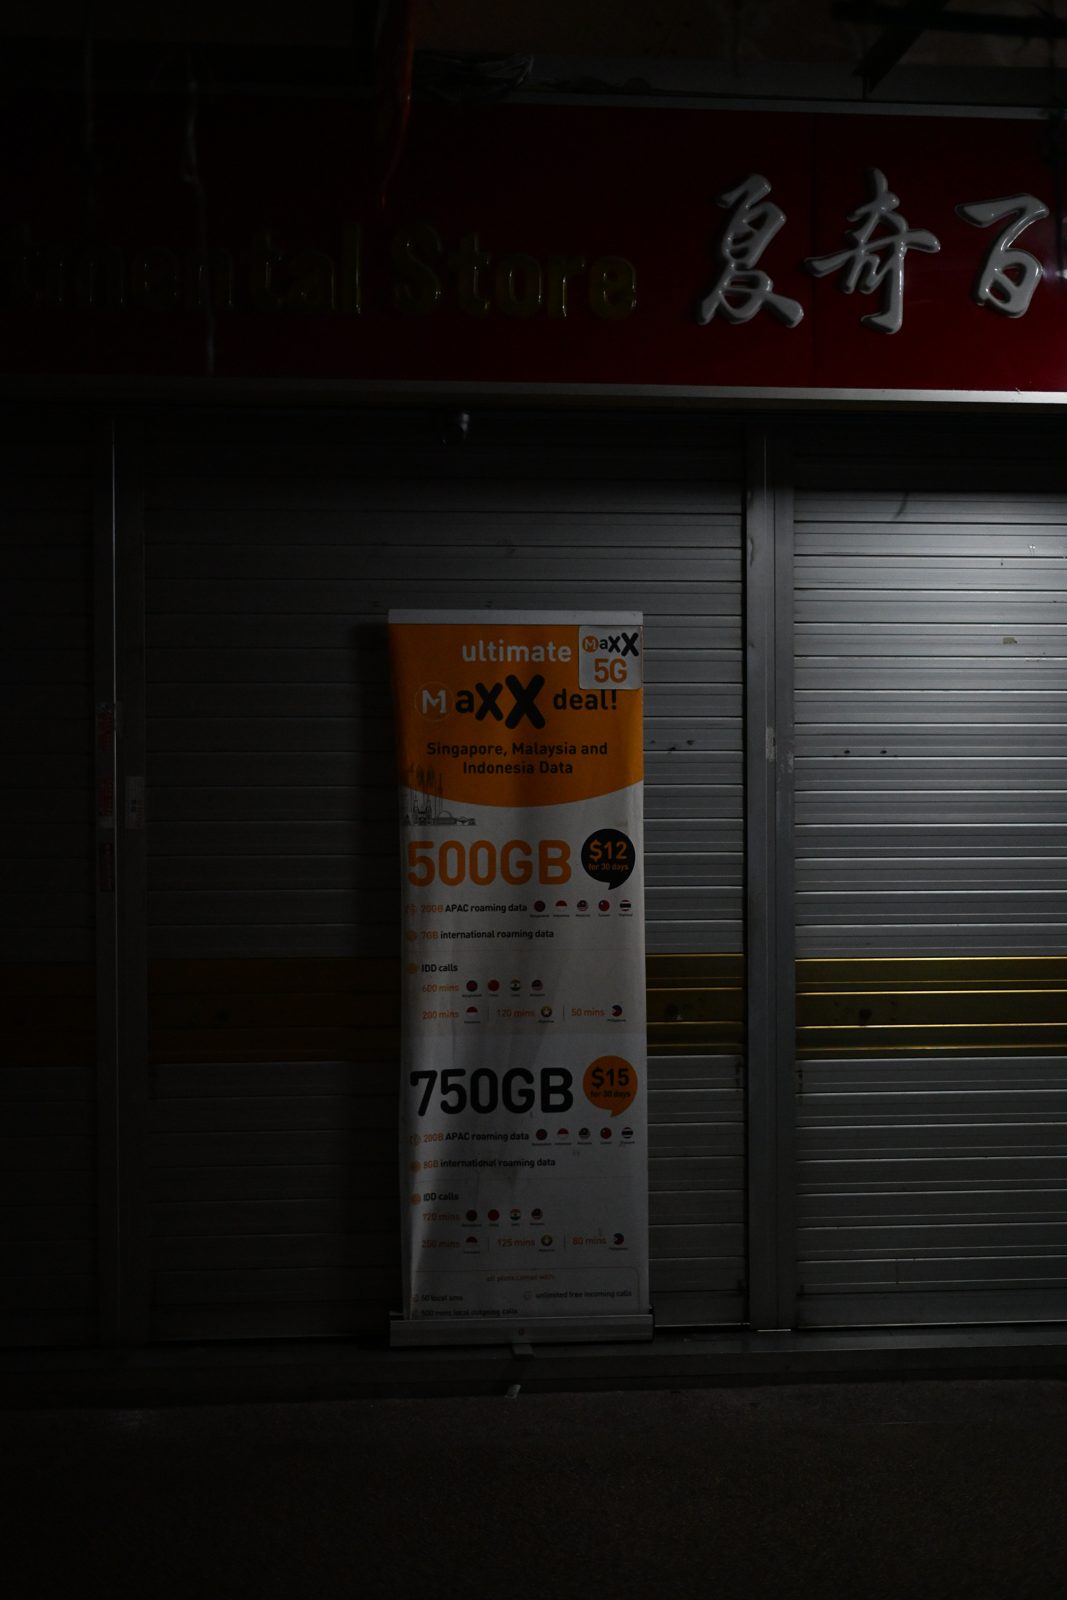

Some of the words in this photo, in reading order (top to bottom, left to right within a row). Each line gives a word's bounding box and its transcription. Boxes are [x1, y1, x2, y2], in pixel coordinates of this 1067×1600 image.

[392, 221, 640, 320] Store
[462, 640, 572, 663] ultimate
[594, 658, 628, 683] 5G
[553, 689, 617, 710] deal!
[427, 742, 507, 758] Singapore,
[512, 742, 576, 758] Malaysia
[581, 742, 608, 755] and
[464, 761, 534, 775] Indonesia
[540, 761, 573, 774] Data
[589, 839, 628, 862] $12
[407, 839, 572, 887] 500GB
[588, 863, 600, 871] for
[611, 863, 629, 872] days
[445, 903, 469, 913] APAC
[471, 903, 506, 914] roaming
[508, 903, 528, 913] data
[440, 930, 495, 939] international
[497, 930, 533, 941] roaming
[535, 929, 554, 938] data
[421, 964, 437, 972] IDD
[439, 963, 458, 972] calls
[439, 984, 459, 992] mins
[439, 1010, 459, 1019] mins
[513, 1008, 535, 1017] mins
[571, 1008, 582, 1017] 50
[583, 1008, 605, 1016] mins
[591, 1066, 629, 1088] $15
[410, 1067, 573, 1116] 750GB
[445, 1132, 470, 1141] APAC
[471, 1132, 508, 1142] roaming
[510, 1132, 529, 1141] data
[440, 1159, 496, 1168] international
[498, 1159, 535, 1169] roaming
[537, 1158, 556, 1166] data
[439, 1192, 459, 1200] calls
[439, 1239, 460, 1248] mins
[514, 1238, 535, 1246] mins
[585, 1236, 607, 1245] mins
